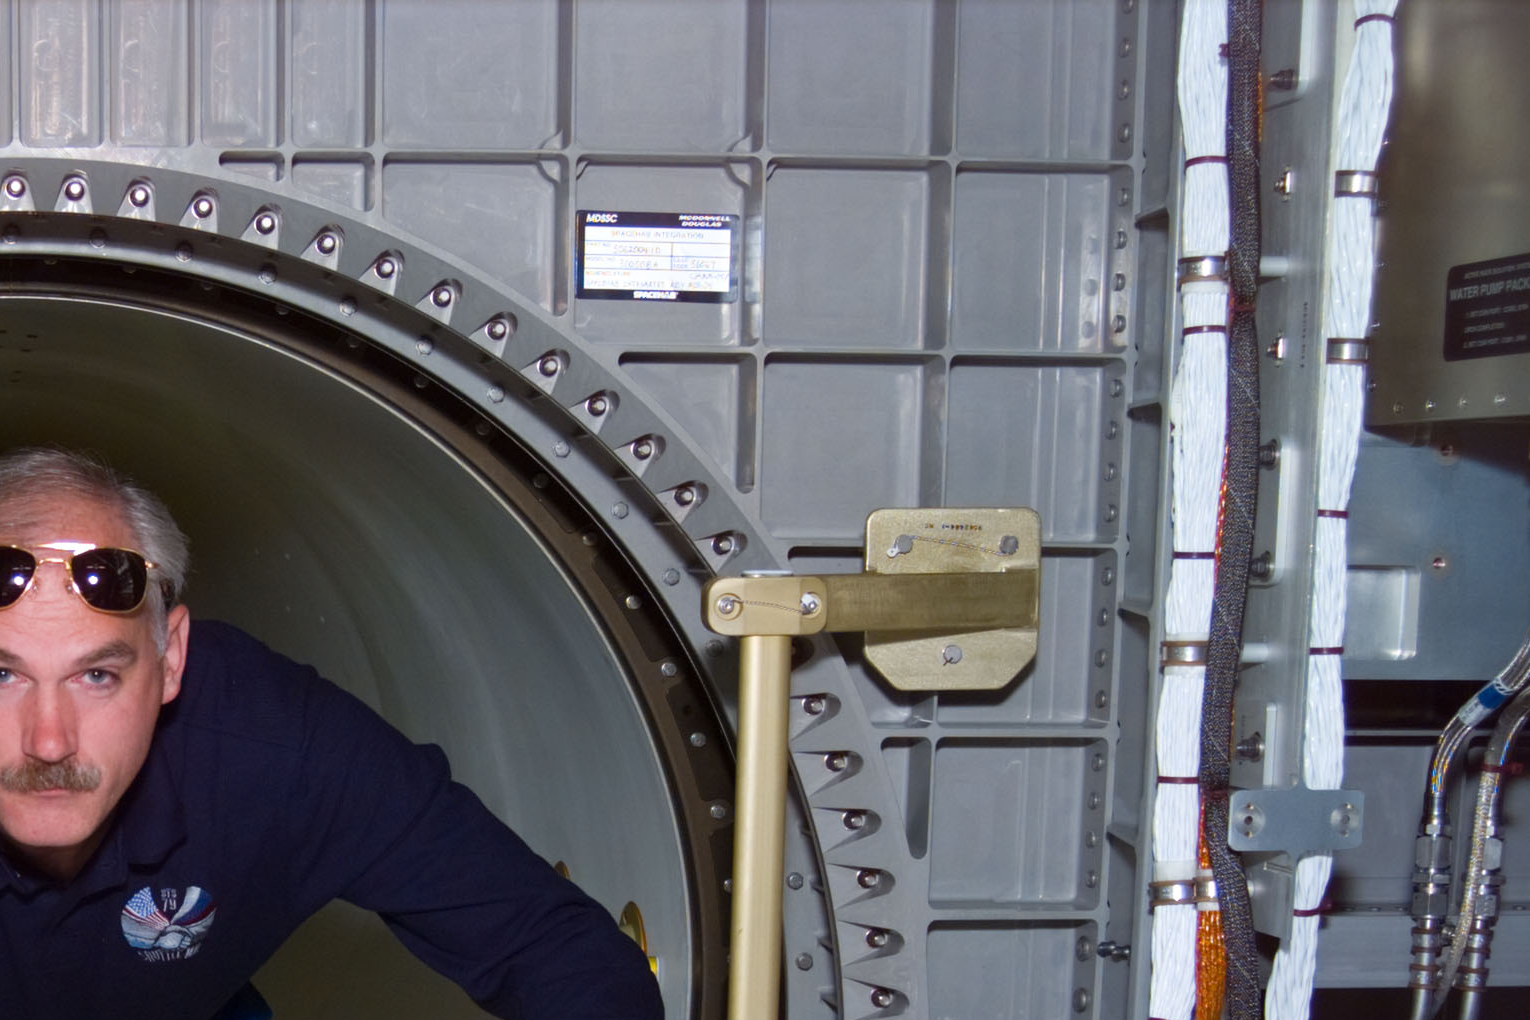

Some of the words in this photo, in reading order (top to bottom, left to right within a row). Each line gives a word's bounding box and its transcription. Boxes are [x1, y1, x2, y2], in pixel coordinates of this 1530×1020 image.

[586, 213, 618, 223] MDSSC
[654, 231, 704, 240] INTEGRATION
[1449, 285, 1479, 302] WATER
[1480, 281, 1504, 297] PUMP
[160, 889, 177, 898] STS
[161, 898, 177, 912] 79
